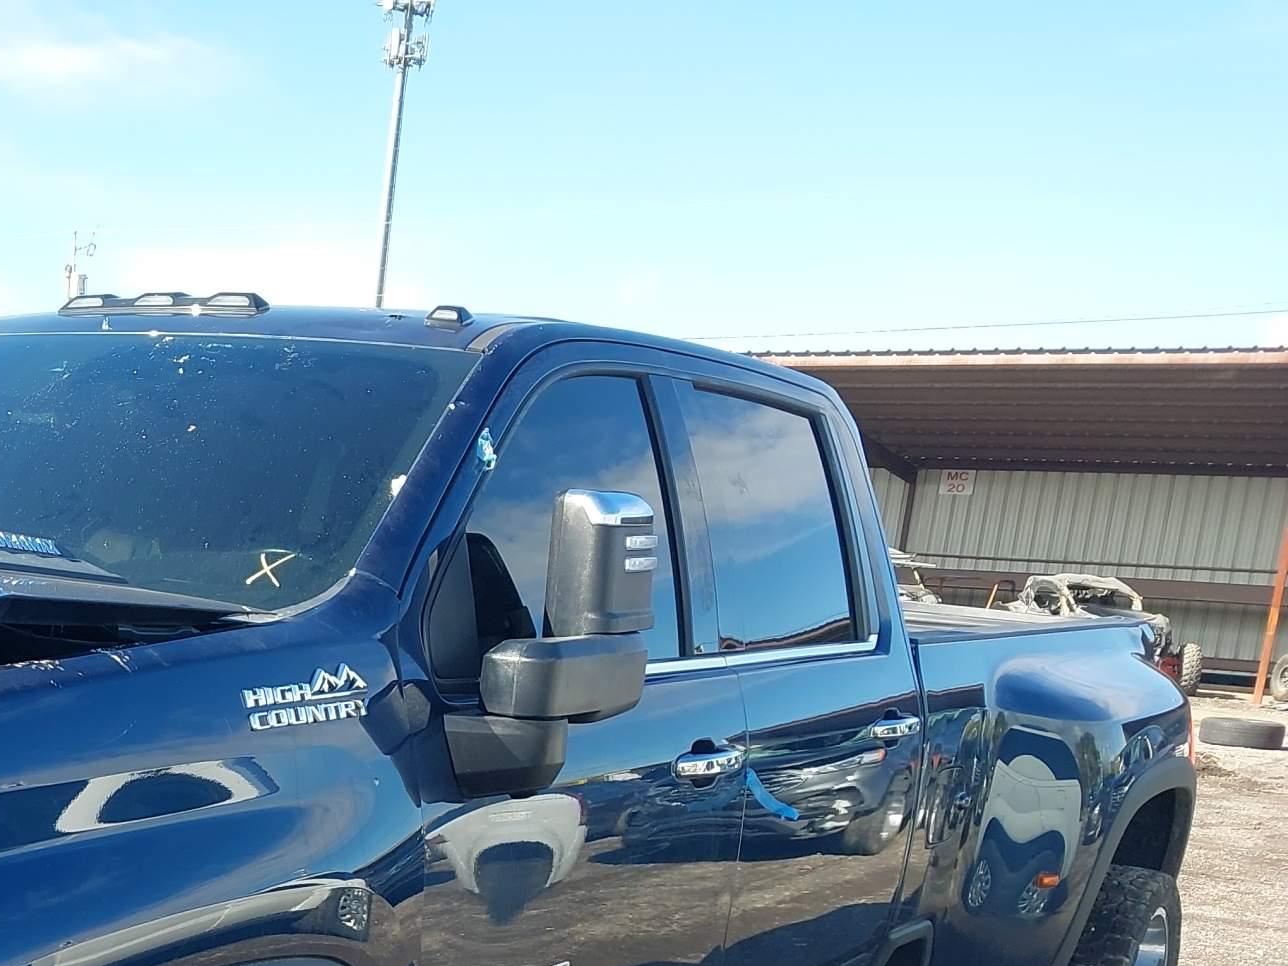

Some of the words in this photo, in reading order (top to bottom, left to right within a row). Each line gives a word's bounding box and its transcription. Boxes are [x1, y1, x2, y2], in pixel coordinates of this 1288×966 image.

[947, 471, 969, 481] MC
[947, 483, 965, 493] 20
[241, 682, 312, 709] HIGH
[248, 699, 369, 731] COUNTRY
